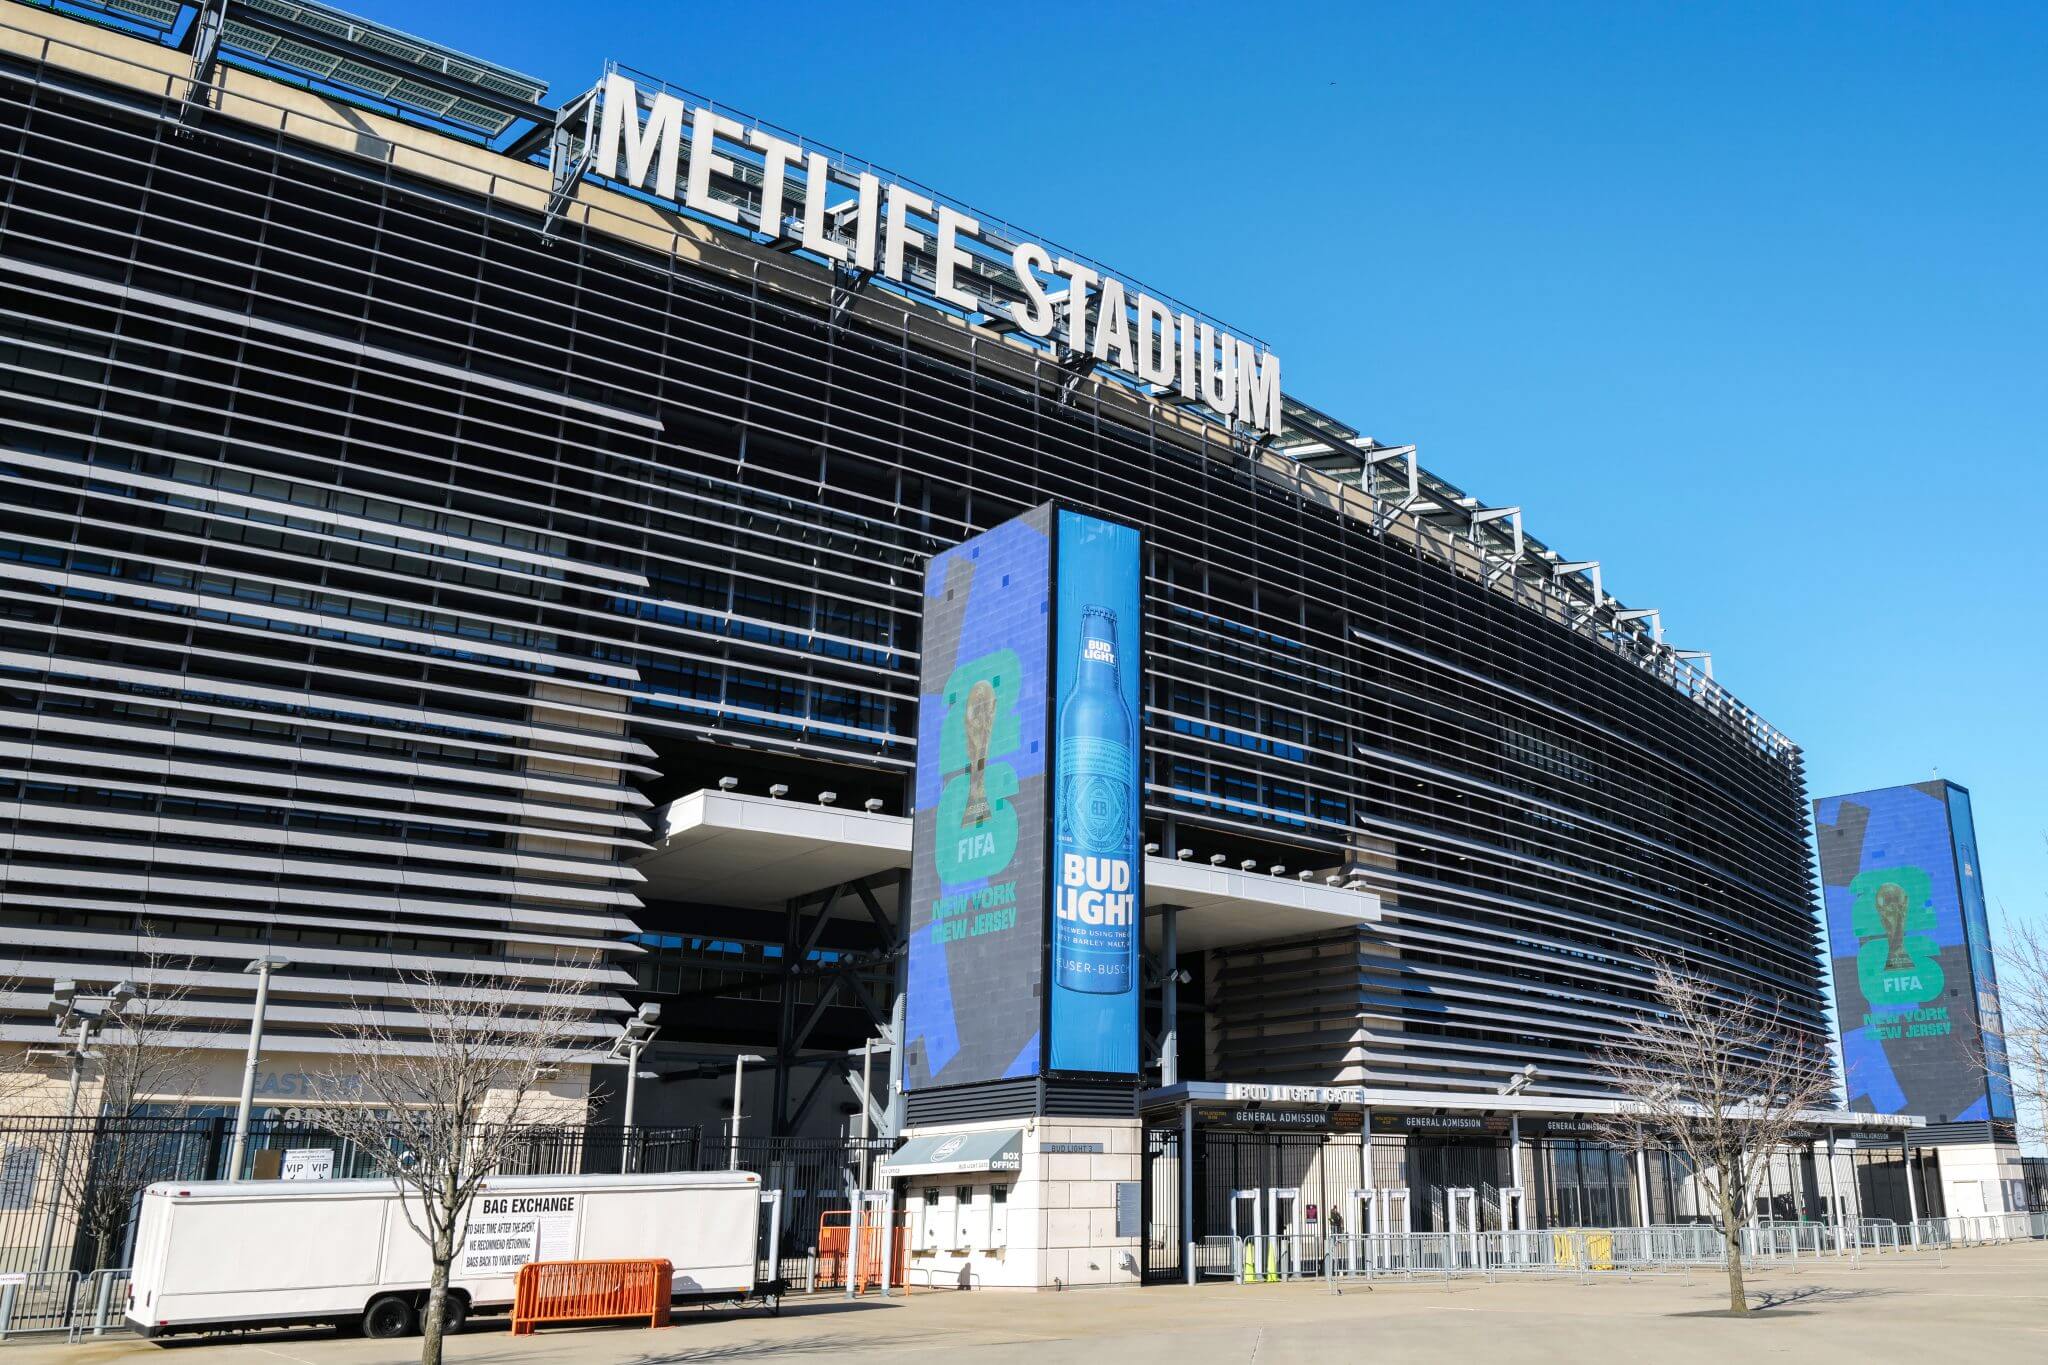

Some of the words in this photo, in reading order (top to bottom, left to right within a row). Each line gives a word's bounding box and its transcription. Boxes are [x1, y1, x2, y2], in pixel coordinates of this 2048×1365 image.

[596, 72, 979, 313] METLIFE
[1010, 242, 1282, 437] STADIUM
[1088, 639, 1111, 652] BUD
[1084, 649, 1115, 664] LIGHT
[957, 831, 996, 863] FIFA
[1064, 853, 1130, 891] BUD
[932, 894, 968, 920] NEW
[972, 880, 1017, 910] YORK
[1056, 885, 1134, 926] LIGHT
[931, 918, 968, 945] NEW
[970, 907, 1017, 937] JERSEY
[1089, 930, 1113, 938] USING
[1072, 937, 1105, 947] BARLEY
[1883, 975, 1923, 993] FIFA
[1904, 1006, 1948, 1022] YORK
[1905, 1021, 1951, 1039] JERSEY
[1237, 1085, 1270, 1100] BUD
[1274, 1086, 1318, 1102] LIGHT
[1325, 1087, 1362, 1103] GATE
[1236, 1111, 1276, 1122] GENERAL
[1279, 1113, 1326, 1123] ADMISSION
[1406, 1117, 1440, 1127] GENERAL
[1442, 1118, 1481, 1128] ADMISSION
[1547, 1121, 1576, 1130] GENERAL
[1051, 1144, 1066, 1153] BUD
[1067, 1144, 1087, 1153] LIGHT
[1002, 1152, 1020, 1161] BOX
[286, 1163, 304, 1173] VIP
[311, 1163, 329, 1172] VIP
[991, 1160, 1020, 1169] OFFICE
[482, 1198, 508, 1214] BAG
[511, 1197, 575, 1213] EXCHANGE
[467, 1224, 474, 1235] TO
[473, 1223, 486, 1235] SAVE
[486, 1223, 497, 1234] TIME
[497, 1222, 511, 1234] AFTER
[511, 1222, 521, 1233] THE
[469, 1240, 476, 1251] WE
[476, 1238, 506, 1251] RECOMMEND
[505, 1237, 531, 1250] RETURNING
[466, 1256, 479, 1268] BAGS
[479, 1256, 492, 1267] BACK
[492, 1256, 498, 1267] TO
[498, 1255, 512, 1267] YOUR
